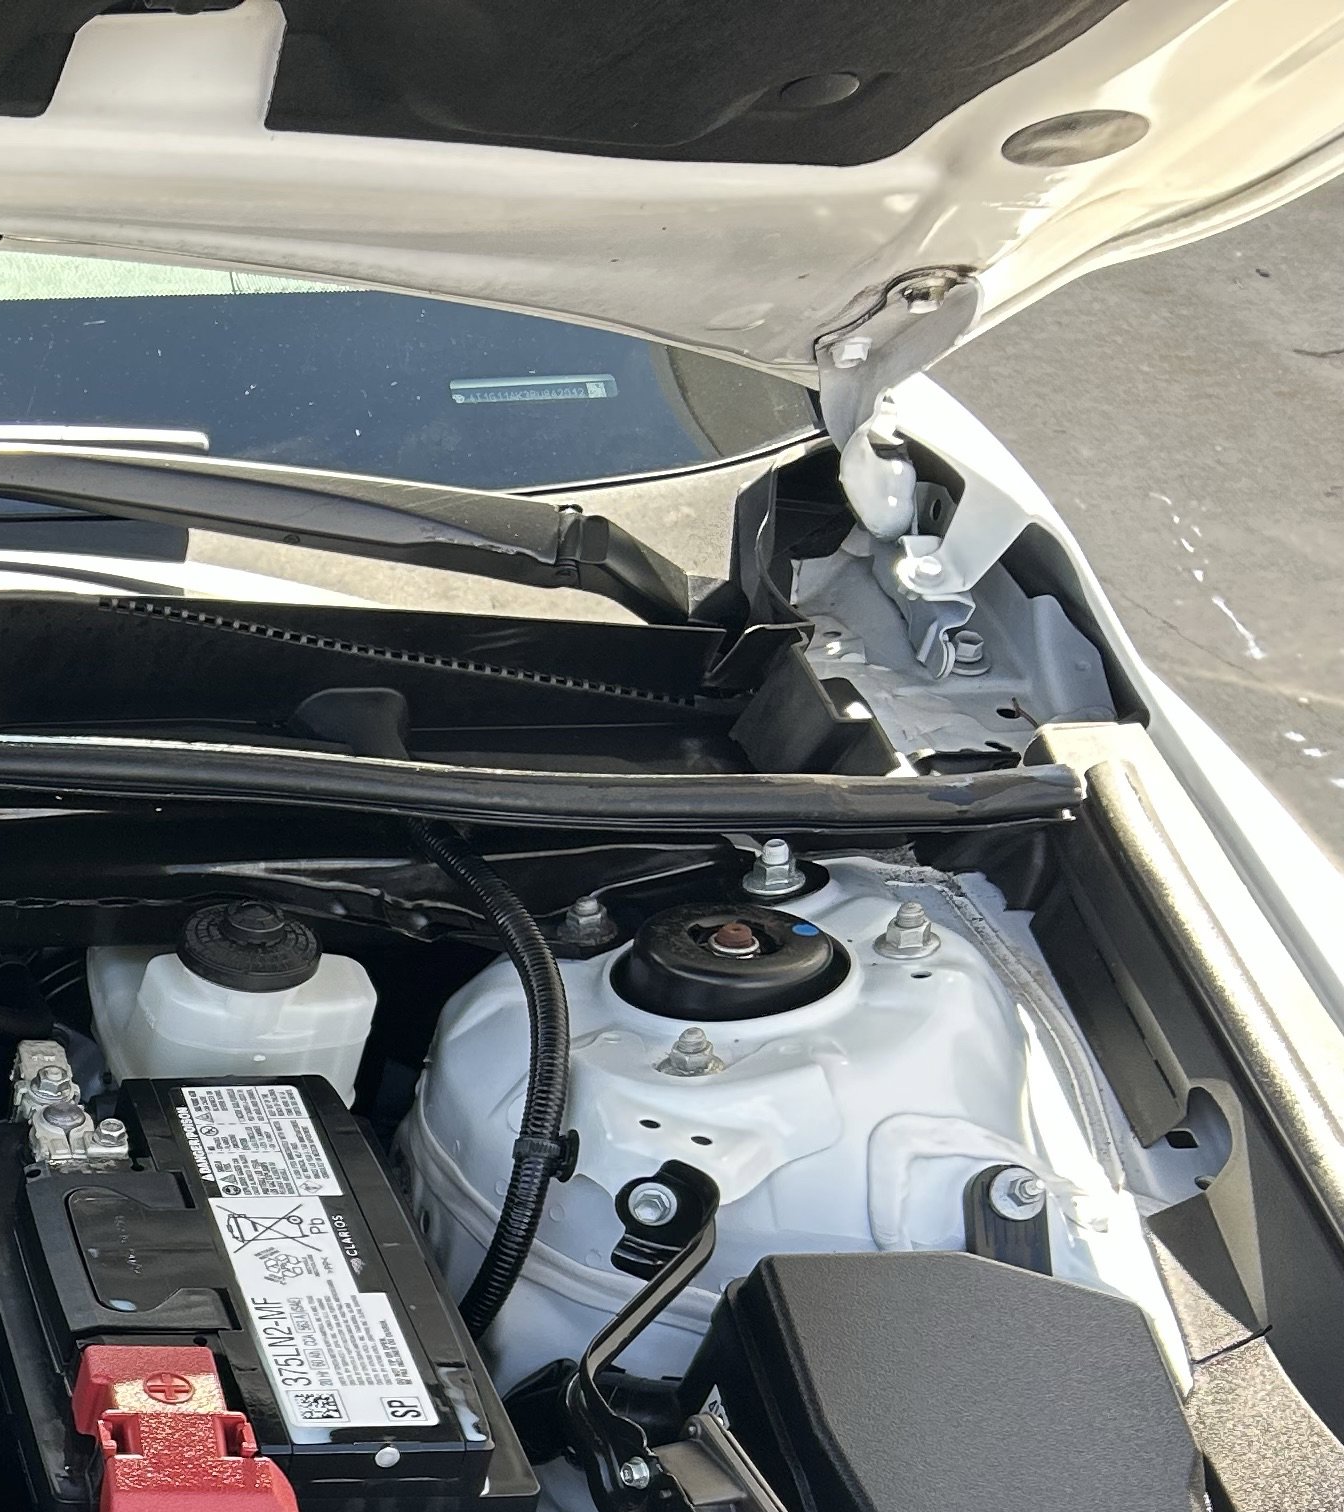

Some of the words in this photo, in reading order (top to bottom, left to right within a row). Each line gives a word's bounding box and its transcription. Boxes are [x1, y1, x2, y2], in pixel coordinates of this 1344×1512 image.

[176, 1107, 212, 1174] DANGER/POISON
[308, 1218, 328, 1235] Pb
[331, 1214, 358, 1257] CLARIOS
[287, 1297, 304, 1313] (SAE)
[251, 1297, 312, 1387] 375LN2-MF
[301, 1335, 317, 1347] CCA
[319, 1378, 334, 1387] 20
[387, 1400, 422, 1419] SP
